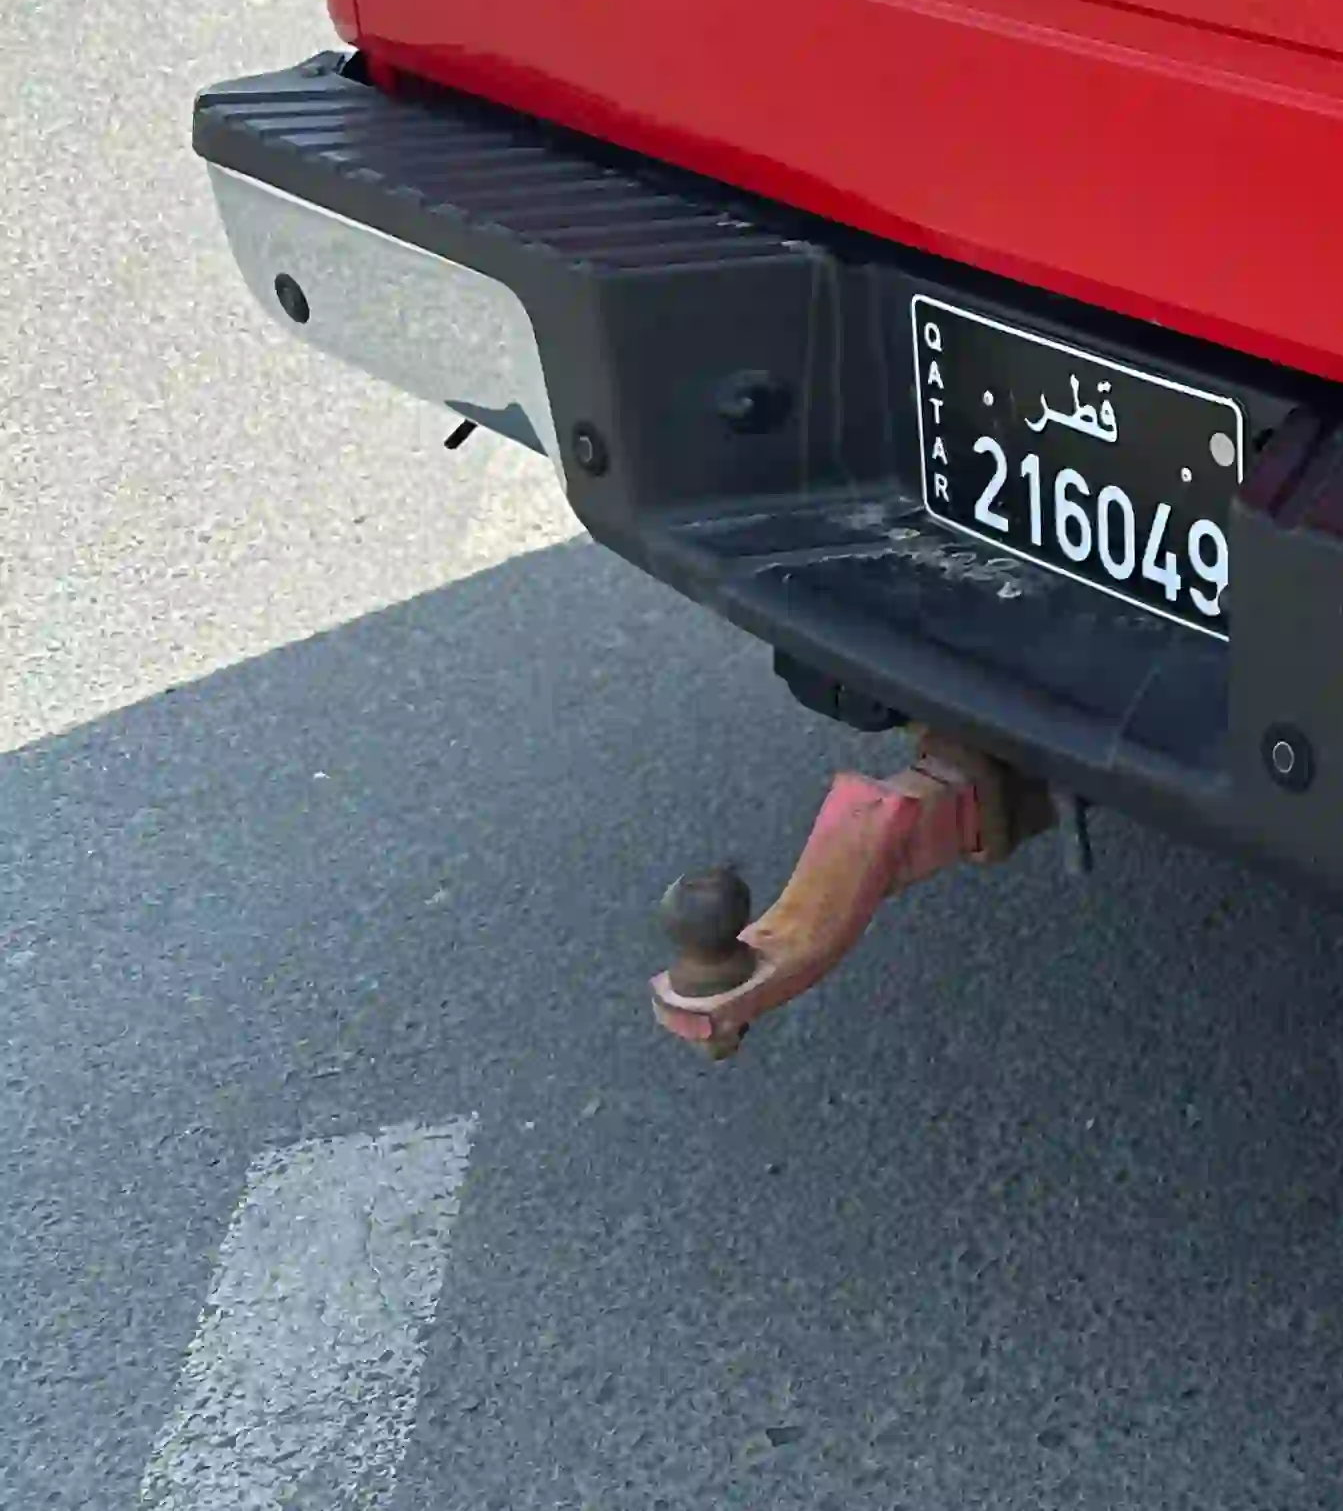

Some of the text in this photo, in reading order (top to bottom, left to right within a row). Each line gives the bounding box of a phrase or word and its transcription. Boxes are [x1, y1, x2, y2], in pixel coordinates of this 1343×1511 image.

[923, 322, 950, 503] QATAR
[1024, 373, 1119, 443] قطر
[972, 435, 1230, 617] 216049
